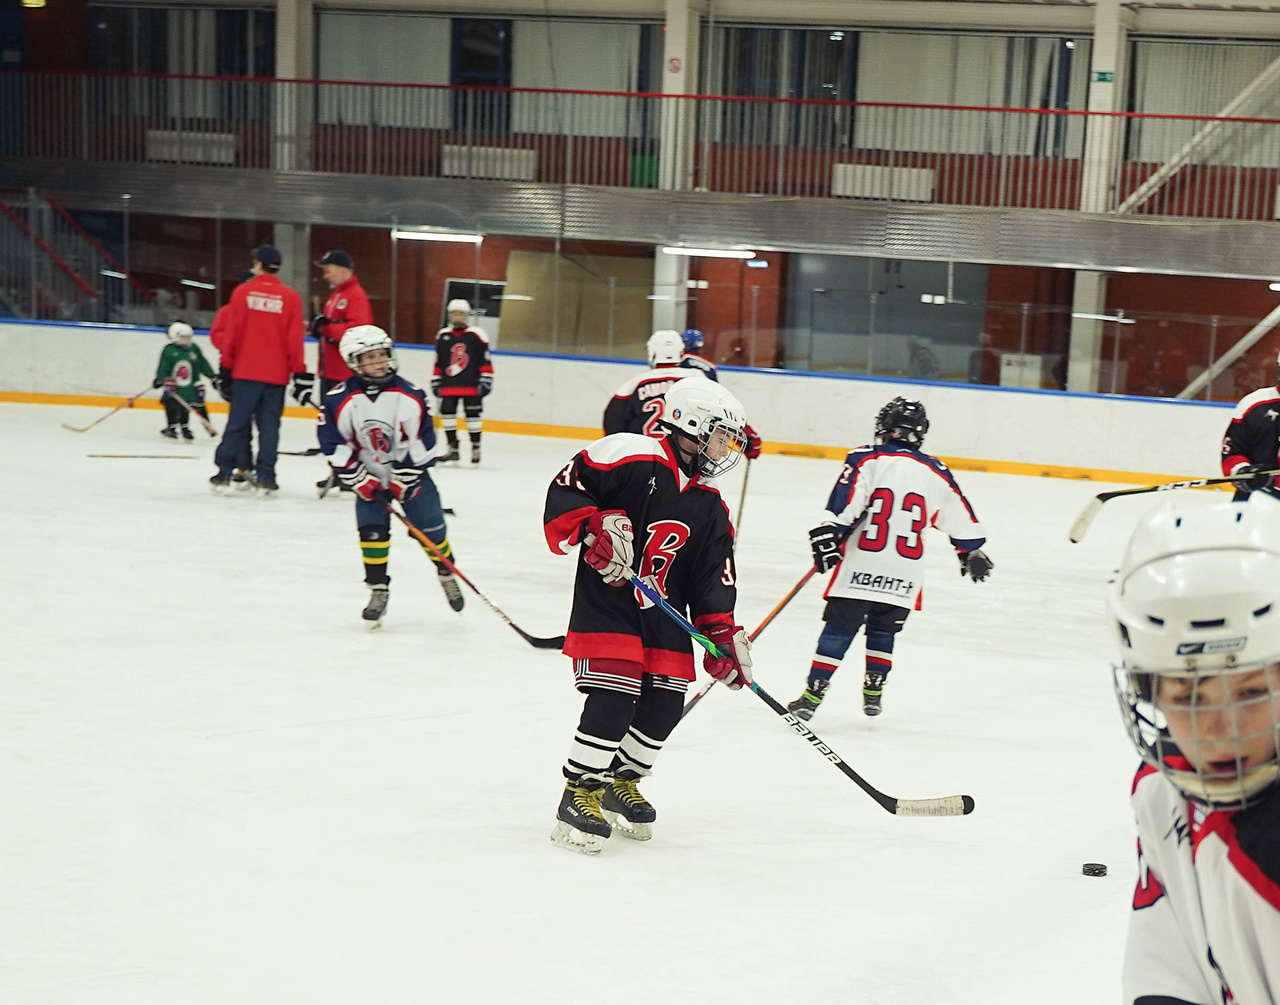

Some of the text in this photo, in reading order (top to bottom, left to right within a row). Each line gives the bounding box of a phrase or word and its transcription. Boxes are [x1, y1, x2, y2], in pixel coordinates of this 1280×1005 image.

[642, 398, 667, 441] 2
[858, 487, 927, 560] 33
[781, 712, 842, 765] BAUER
